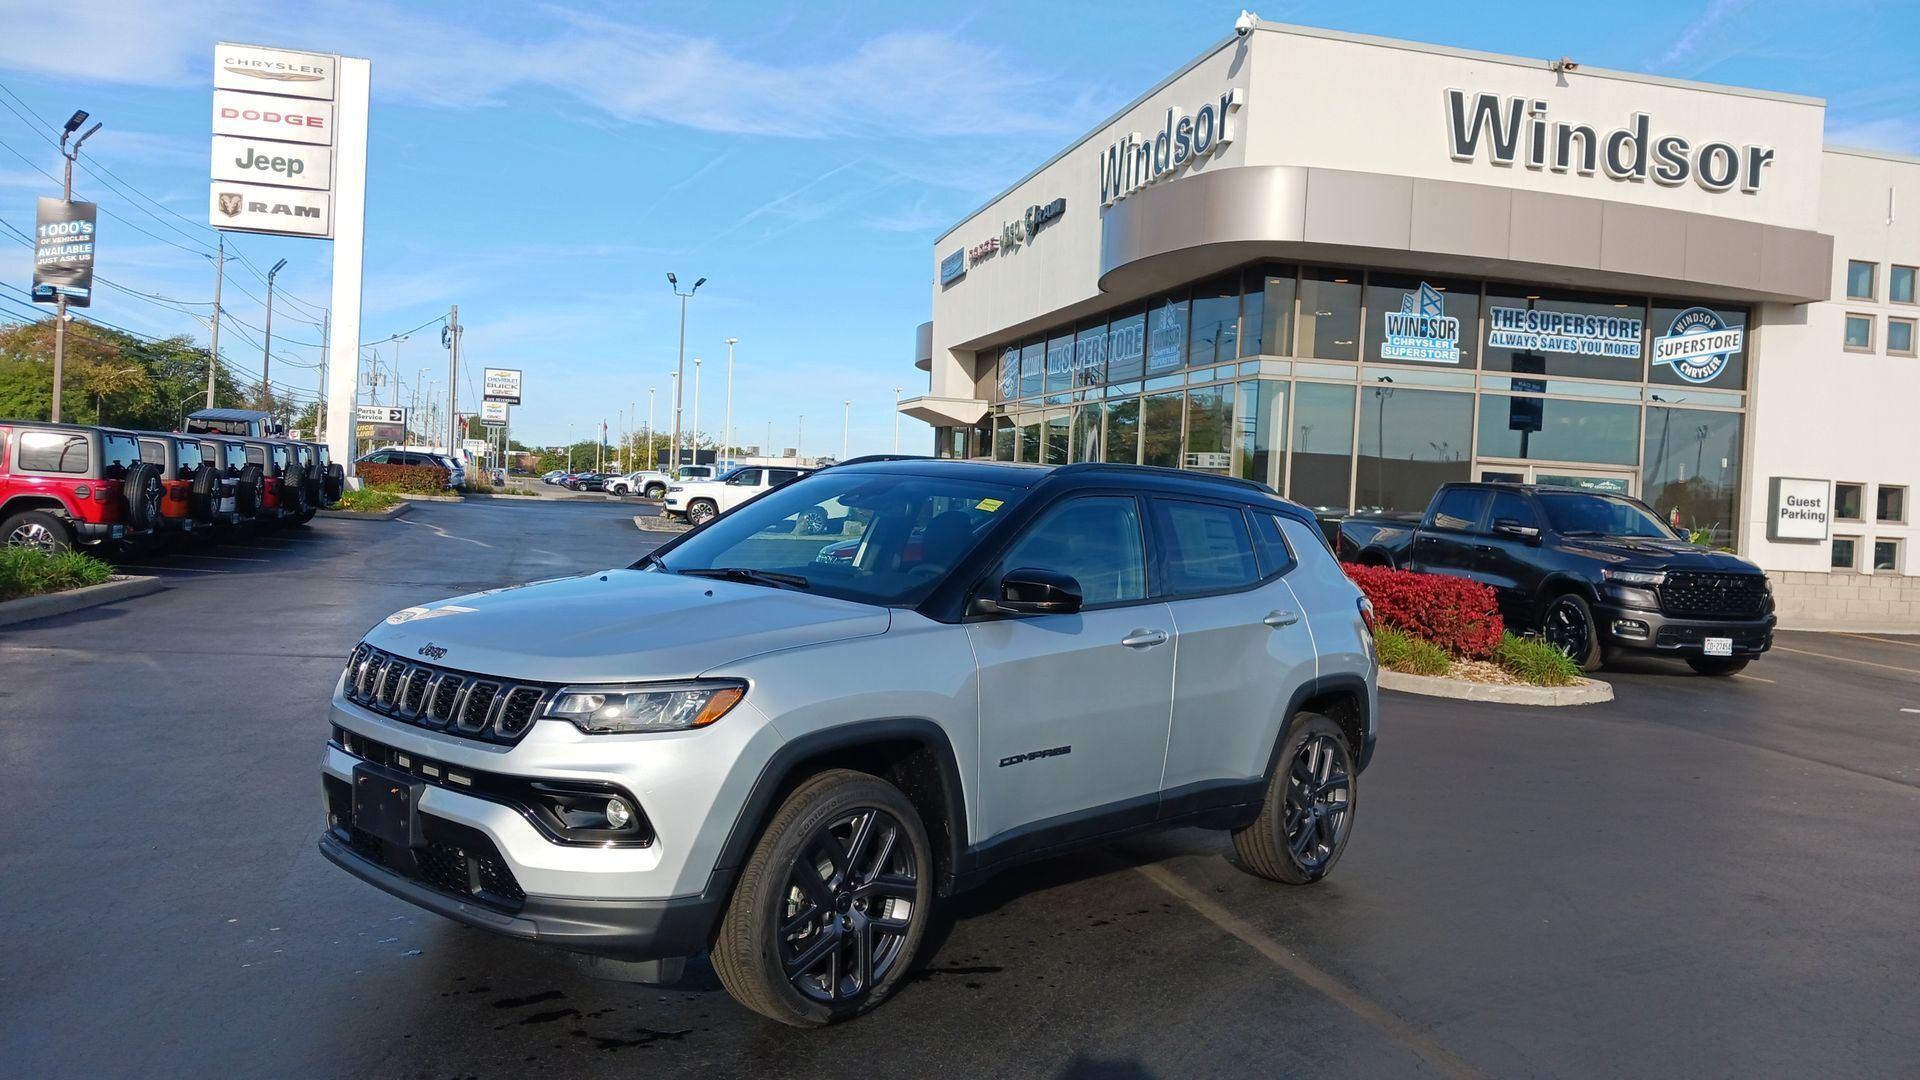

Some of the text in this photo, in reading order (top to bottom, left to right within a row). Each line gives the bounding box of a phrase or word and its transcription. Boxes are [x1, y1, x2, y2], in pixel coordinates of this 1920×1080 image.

[225, 57, 324, 74] CHRYSLER
[221, 107, 324, 128] DODGE
[1099, 88, 1243, 207] Windsor
[1444, 87, 1776, 193] Windsor
[235, 148, 305, 178] Jeep
[248, 201, 321, 219] RAM
[52, 235, 90, 243] VEHICLES
[37, 256, 57, 265] JUST
[60, 254, 77, 262] ASK
[38, 243, 92, 257] AVAILABLE
[1387, 315, 1457, 340] WINDSOR
[1492, 309, 1640, 339] THE SUPERSTORE
[1675, 313, 1717, 333] WINDSOR
[1062, 324, 1143, 374] SUPERSTORE
[1384, 346, 1457, 360] SUPERSTORE
[1393, 338, 1450, 349] CHRYSLER
[1490, 333, 1639, 356] ALWAYS SAVES YOU MORE!
[1657, 333, 1739, 358] SUPERSTORE
[1680, 356, 1722, 378] CHRYSLER
[1786, 495, 1821, 508] Guest
[1780, 508, 1826, 523] Parking
[418, 641, 448, 660] Jeep
[998, 745, 1071, 768] COMPASS
